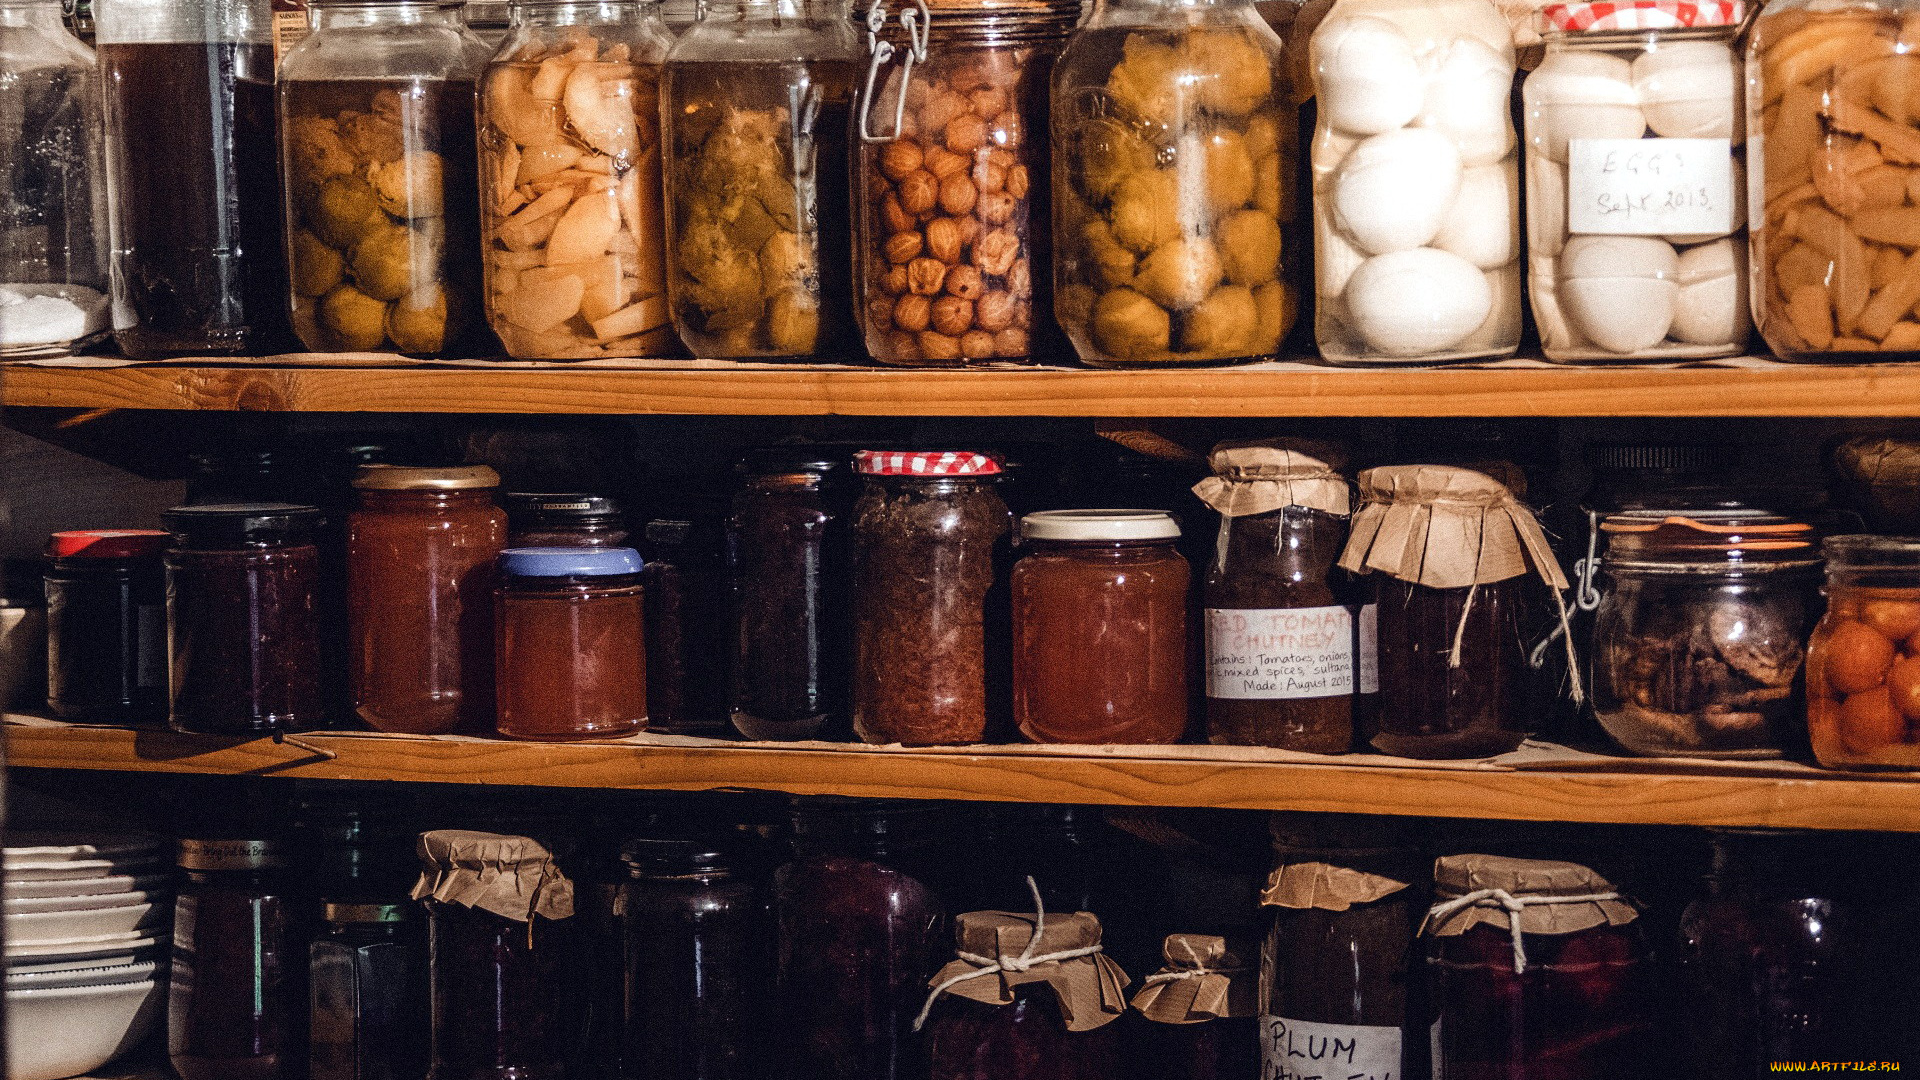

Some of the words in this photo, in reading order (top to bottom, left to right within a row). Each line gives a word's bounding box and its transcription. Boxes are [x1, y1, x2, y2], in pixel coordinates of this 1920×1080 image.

[1233, 631, 1335, 650] CHUTNEY
[1286, 677, 1326, 692] August
[1270, 1020, 1356, 1063] PLUM
